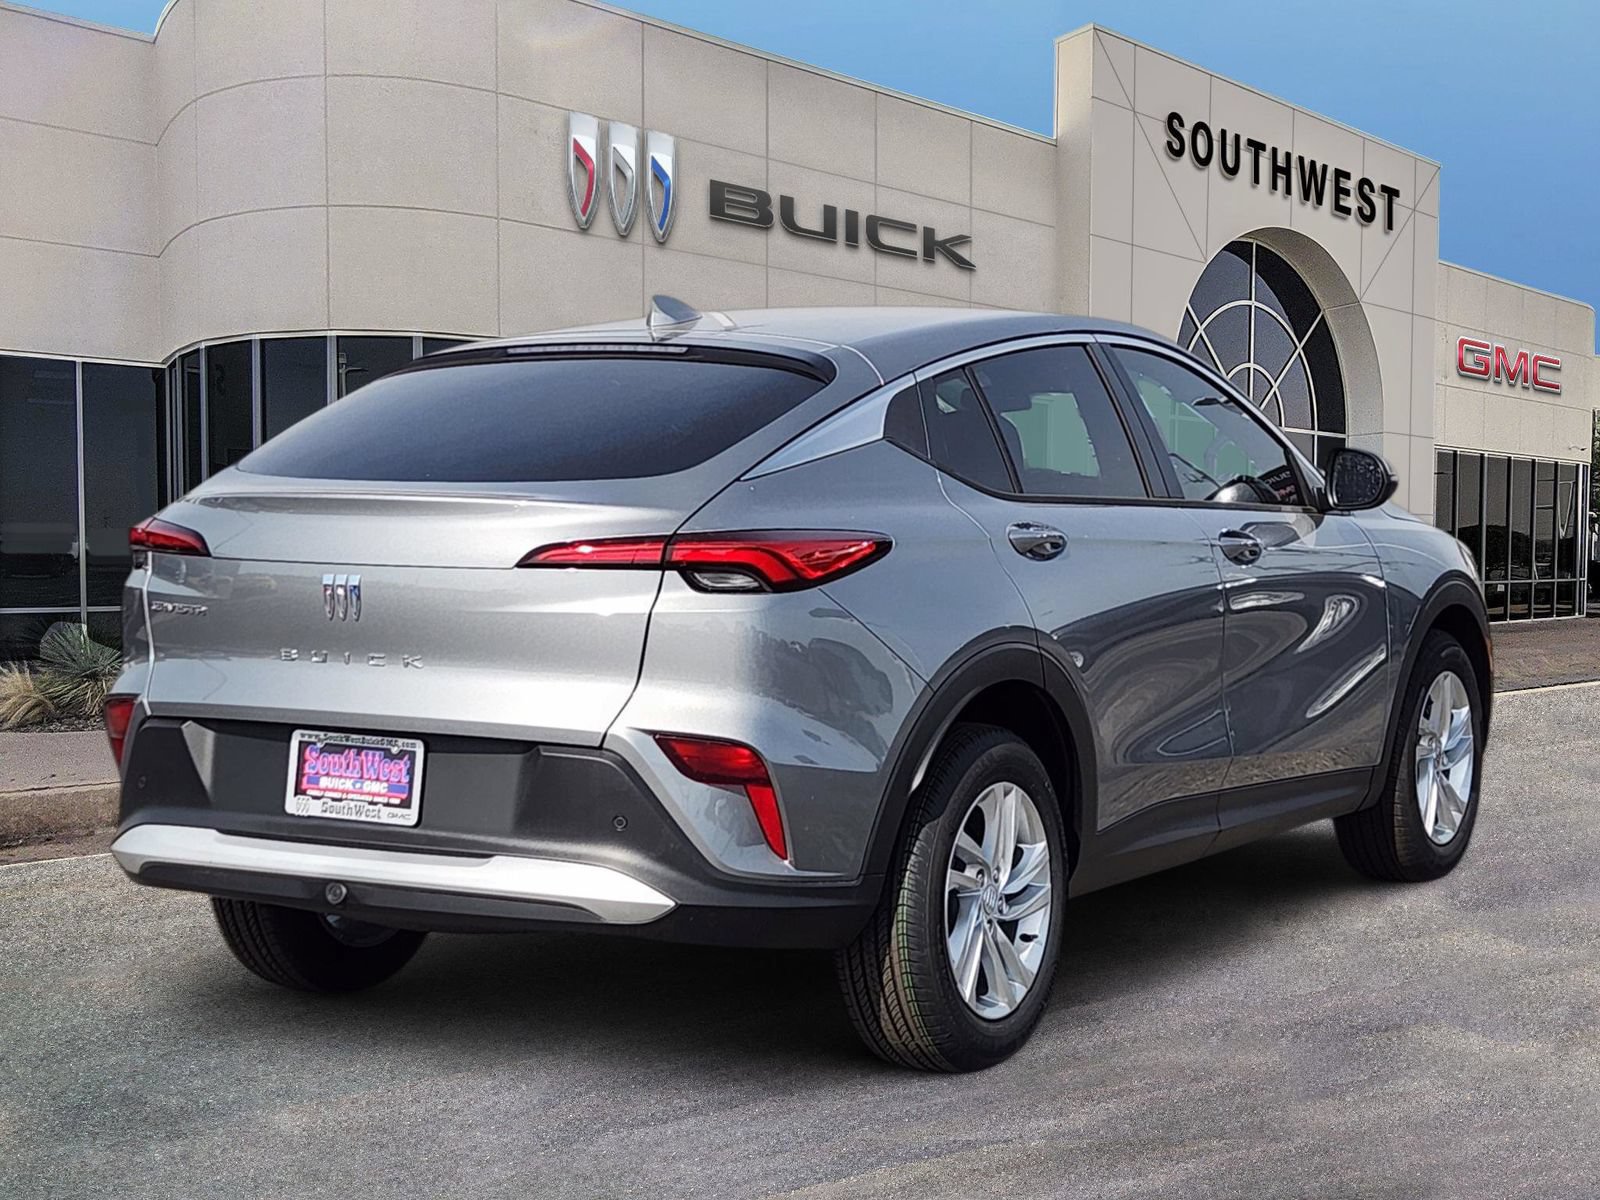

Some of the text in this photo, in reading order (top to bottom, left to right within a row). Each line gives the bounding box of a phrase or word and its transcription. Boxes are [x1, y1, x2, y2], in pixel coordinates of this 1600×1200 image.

[1166, 111, 1400, 232] SOUTHWEST
[709, 179, 976, 270] BUICK
[1457, 336, 1561, 394] GMC
[280, 648, 424, 668] BUICK
[320, 776, 389, 793] BUICK GMC
[321, 801, 382, 820] SouthWest
